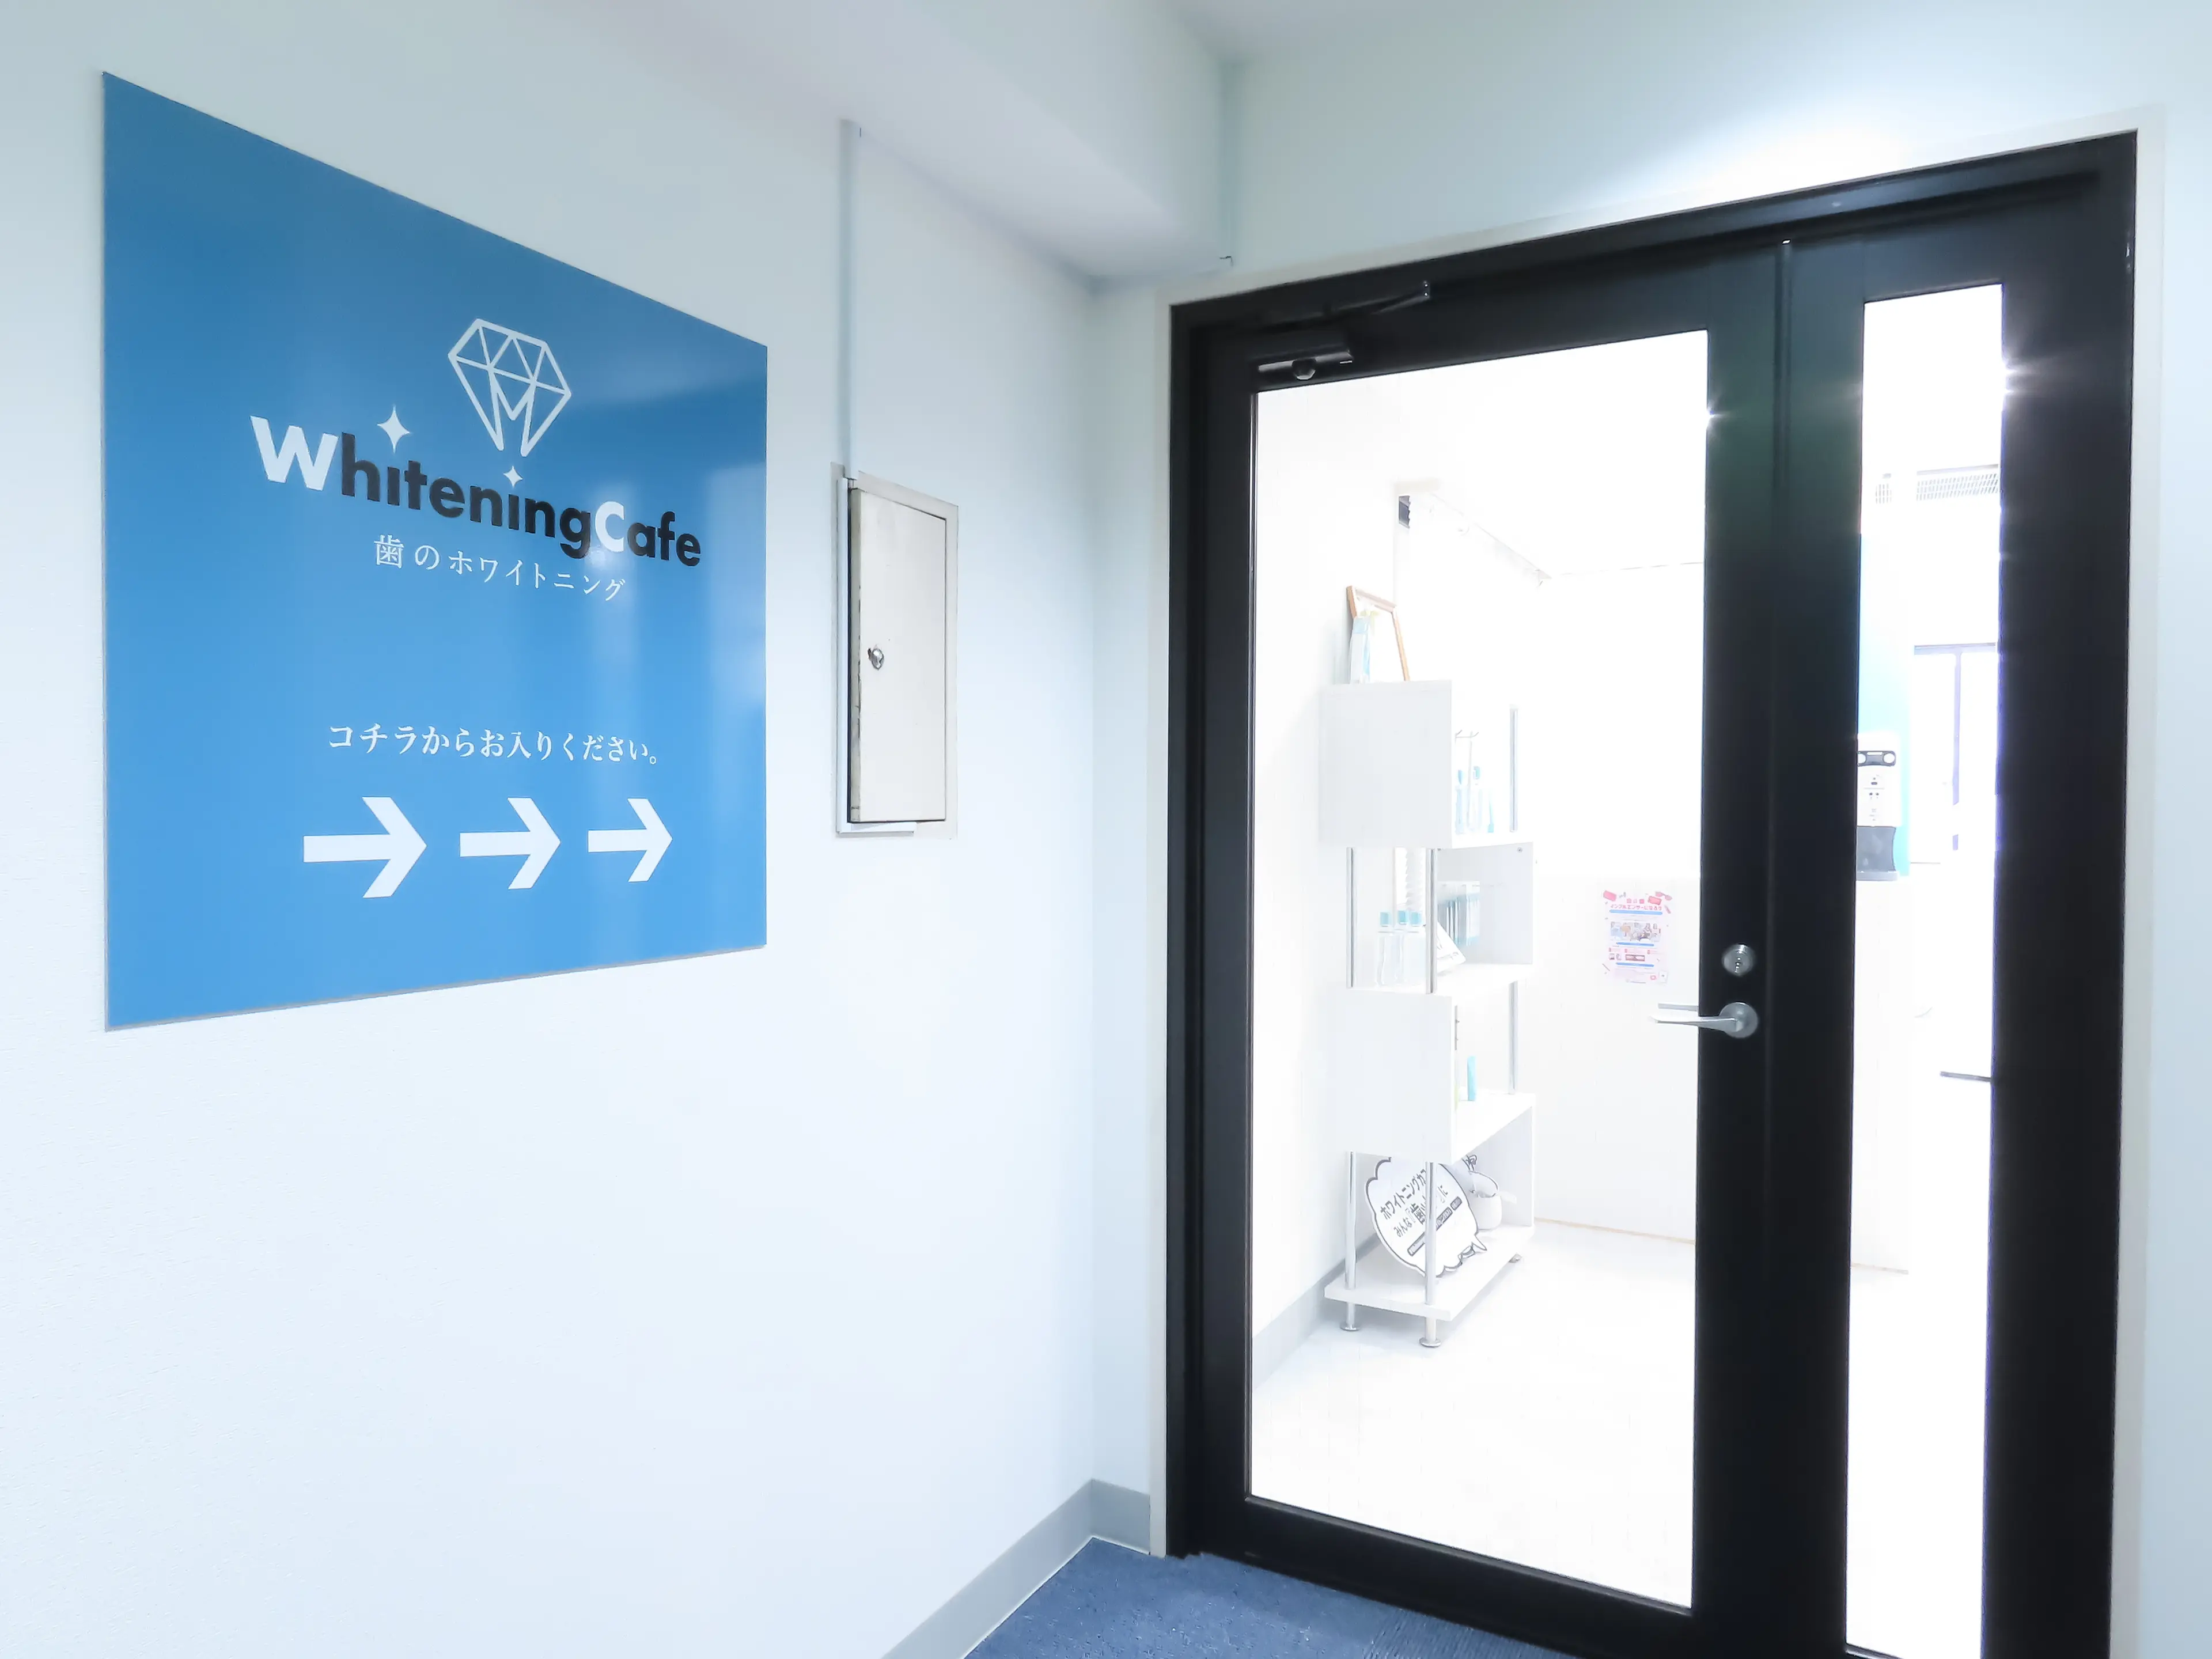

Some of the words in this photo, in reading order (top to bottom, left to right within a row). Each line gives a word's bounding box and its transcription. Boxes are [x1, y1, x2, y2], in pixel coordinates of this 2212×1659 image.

[374, 533, 627, 601] 歯のホワイトニング
[328, 722, 658, 765] コチラからお入りください。
